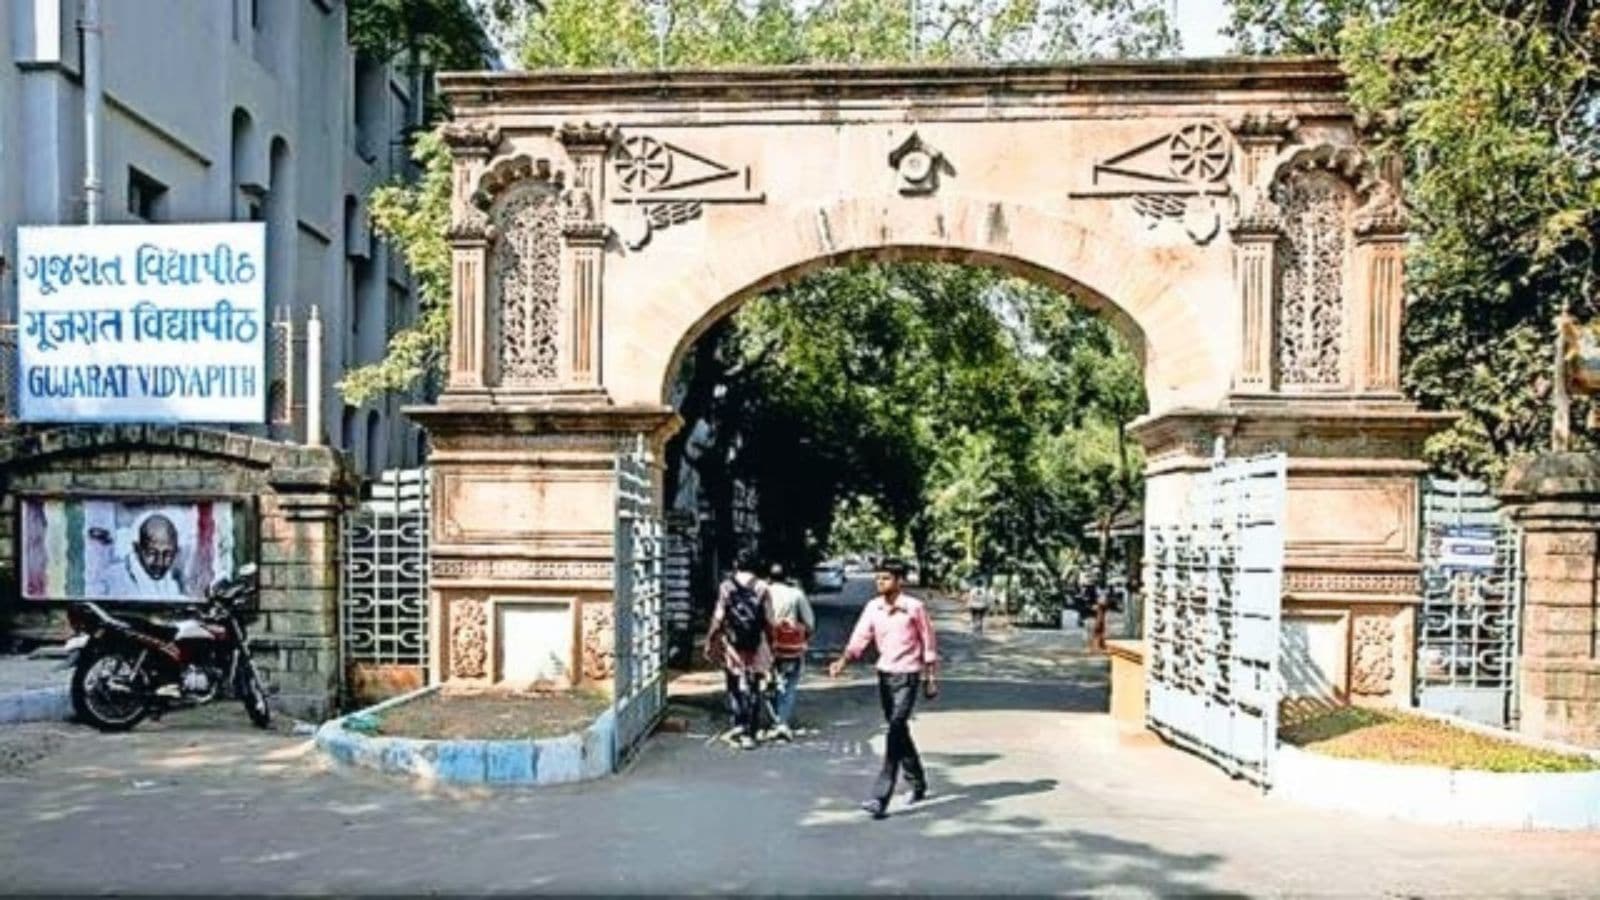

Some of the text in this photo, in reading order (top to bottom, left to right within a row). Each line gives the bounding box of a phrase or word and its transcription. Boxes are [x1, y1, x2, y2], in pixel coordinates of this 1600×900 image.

[130, 299, 258, 344] विद्यापीठ
[28, 364, 256, 398] GUJARAT VIDYAPITH
